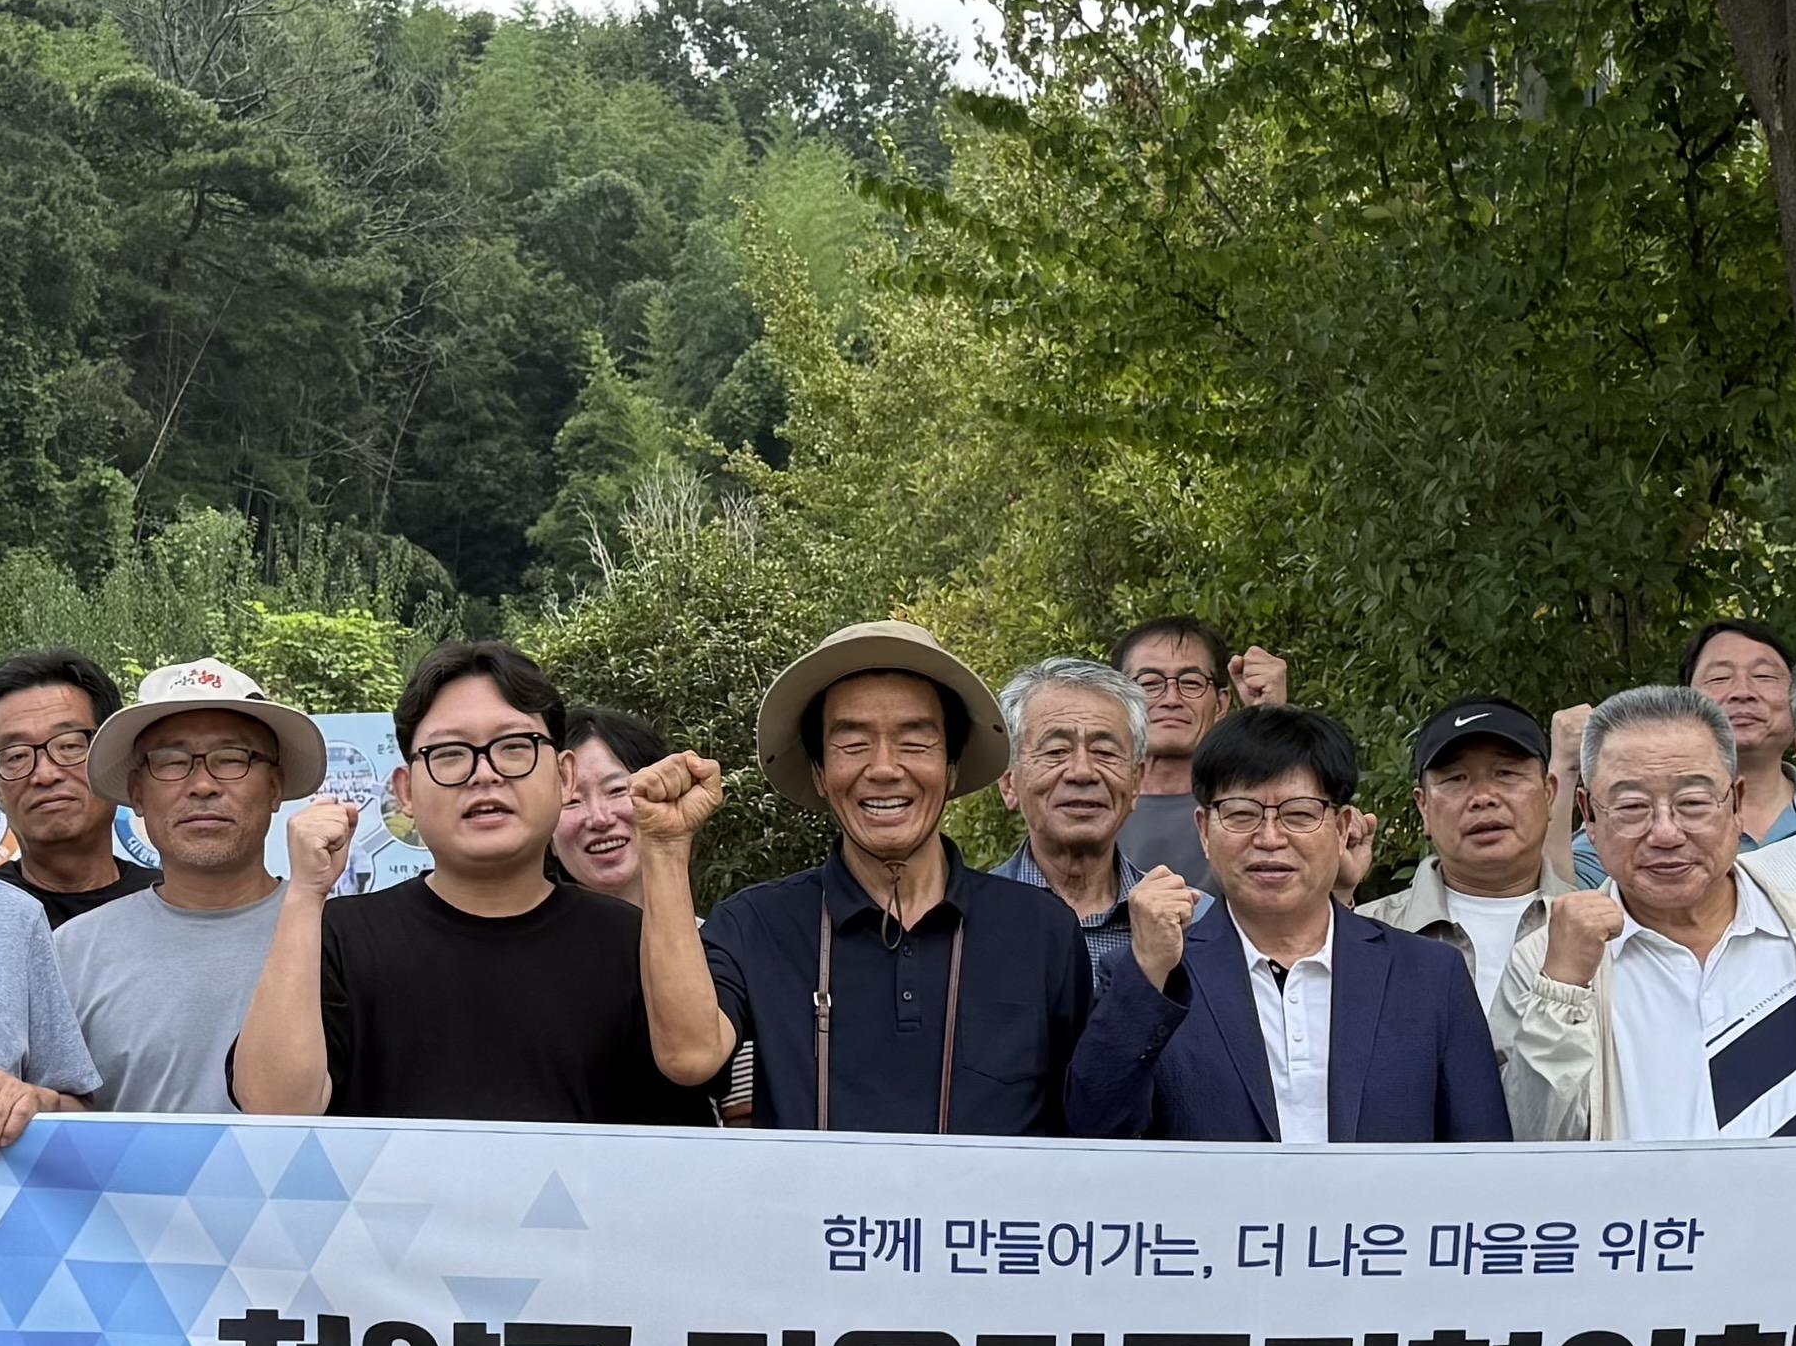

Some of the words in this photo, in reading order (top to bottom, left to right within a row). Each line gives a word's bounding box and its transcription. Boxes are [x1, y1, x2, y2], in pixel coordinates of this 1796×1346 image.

[823, 1214, 922, 1273] 함께
[945, 1219, 1213, 1280] 만들어가는,
[1237, 1222, 1285, 1277] 더
[1307, 1222, 1408, 1277] 나은
[1429, 1221, 1580, 1276] 마을을
[1598, 1217, 1705, 1273] 위한
